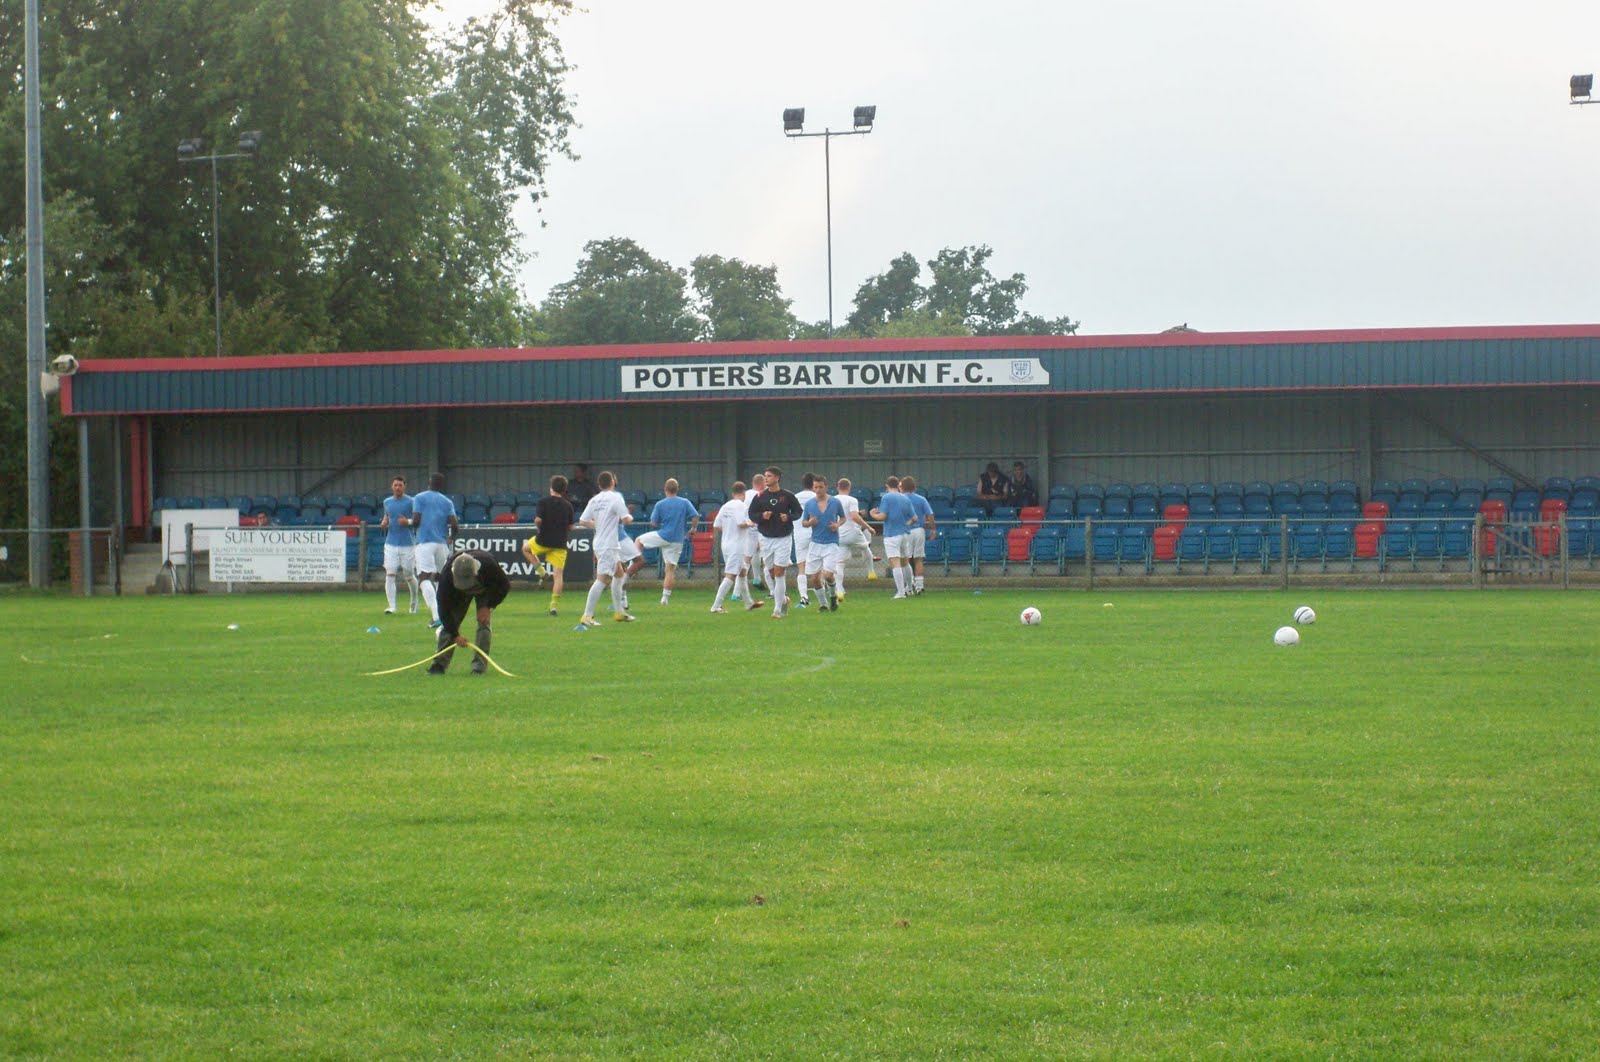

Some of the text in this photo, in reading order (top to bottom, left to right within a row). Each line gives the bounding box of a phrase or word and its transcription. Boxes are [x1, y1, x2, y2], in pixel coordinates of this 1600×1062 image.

[773, 364, 833, 386] BAR
[842, 363, 926, 385] TOWN
[936, 362, 993, 384] F.C.
[224, 531, 330, 544] SUIT YOURSELF
[454, 538, 517, 552] SOUTH
